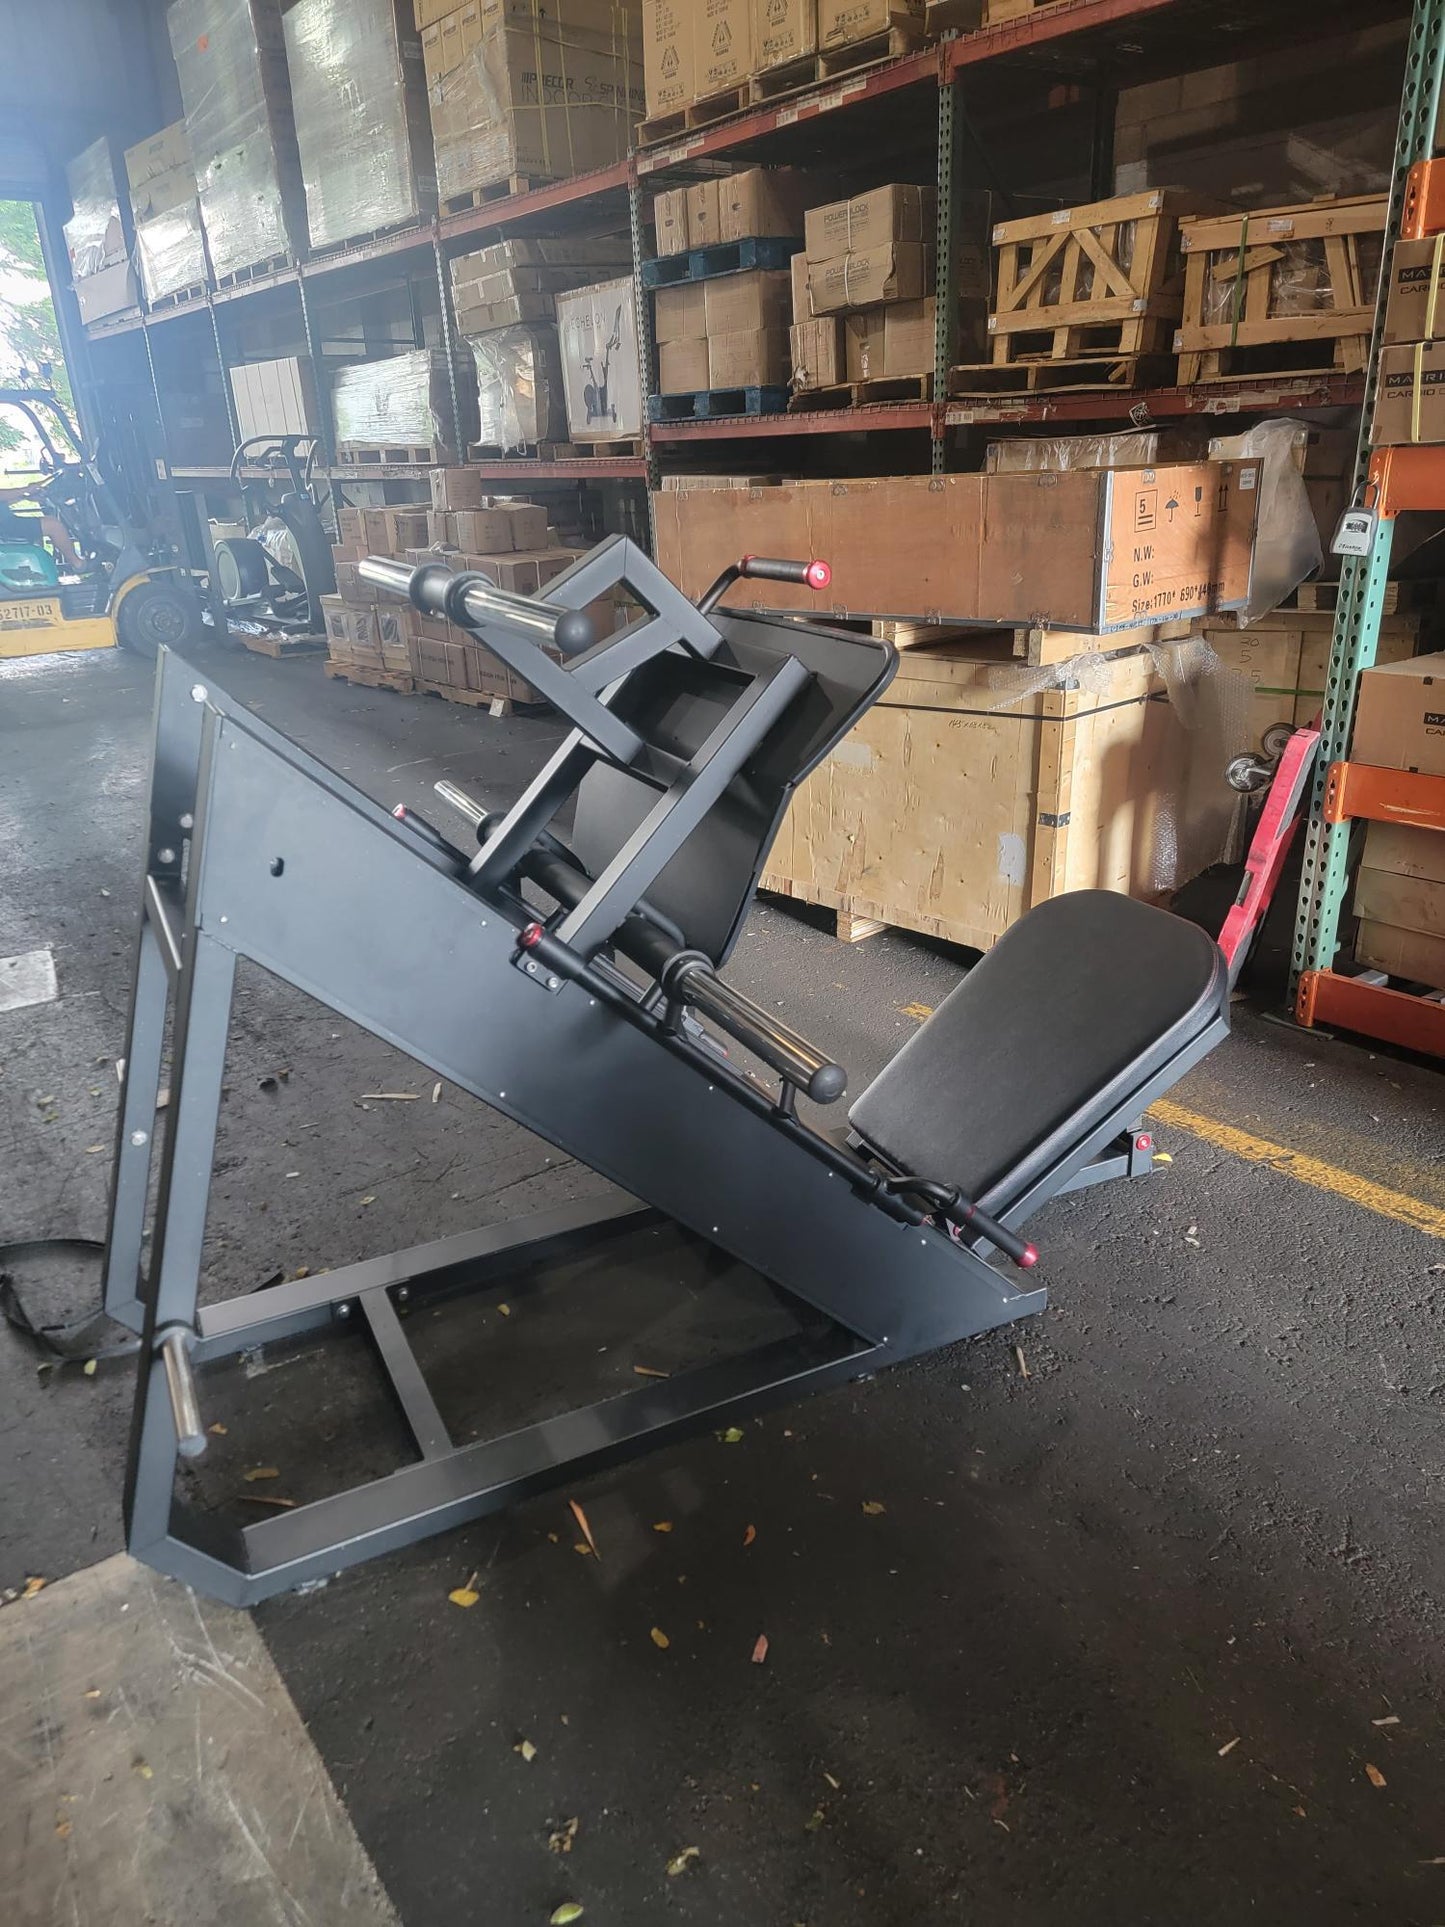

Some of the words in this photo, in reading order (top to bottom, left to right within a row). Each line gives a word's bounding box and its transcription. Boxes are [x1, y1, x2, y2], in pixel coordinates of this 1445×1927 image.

[522, 72, 574, 89] PECOR
[824, 203, 869, 222] POWERLOCK
[826, 259, 870, 277] POWEBLOCK
[1388, 373, 1443, 386] MARI
[1387, 388, 1436, 399] CARIO
[1139, 498, 1146, 514] 5
[1133, 545, 1155, 562] N.W:
[1132, 571, 1154, 588] G.W:
